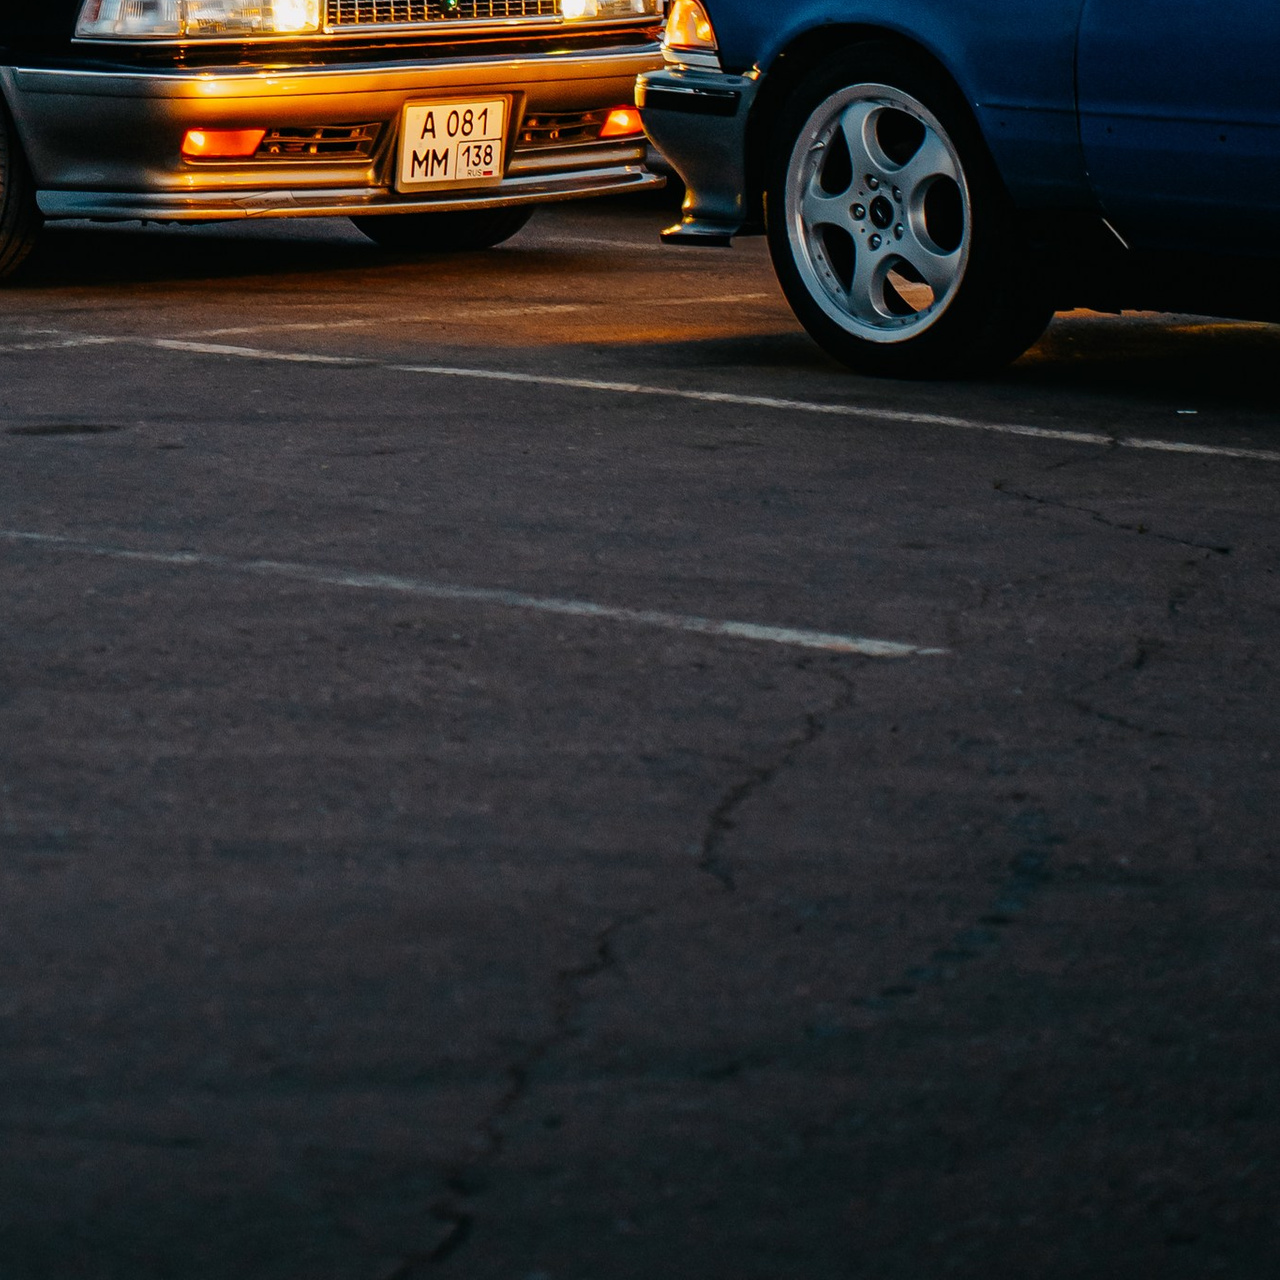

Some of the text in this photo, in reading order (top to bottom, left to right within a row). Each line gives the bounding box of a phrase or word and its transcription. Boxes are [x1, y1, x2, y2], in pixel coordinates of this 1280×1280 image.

[421, 108, 489, 140] А 081
[411, 145, 493, 178] ММ 138
[467, 168, 482, 177] RUS
